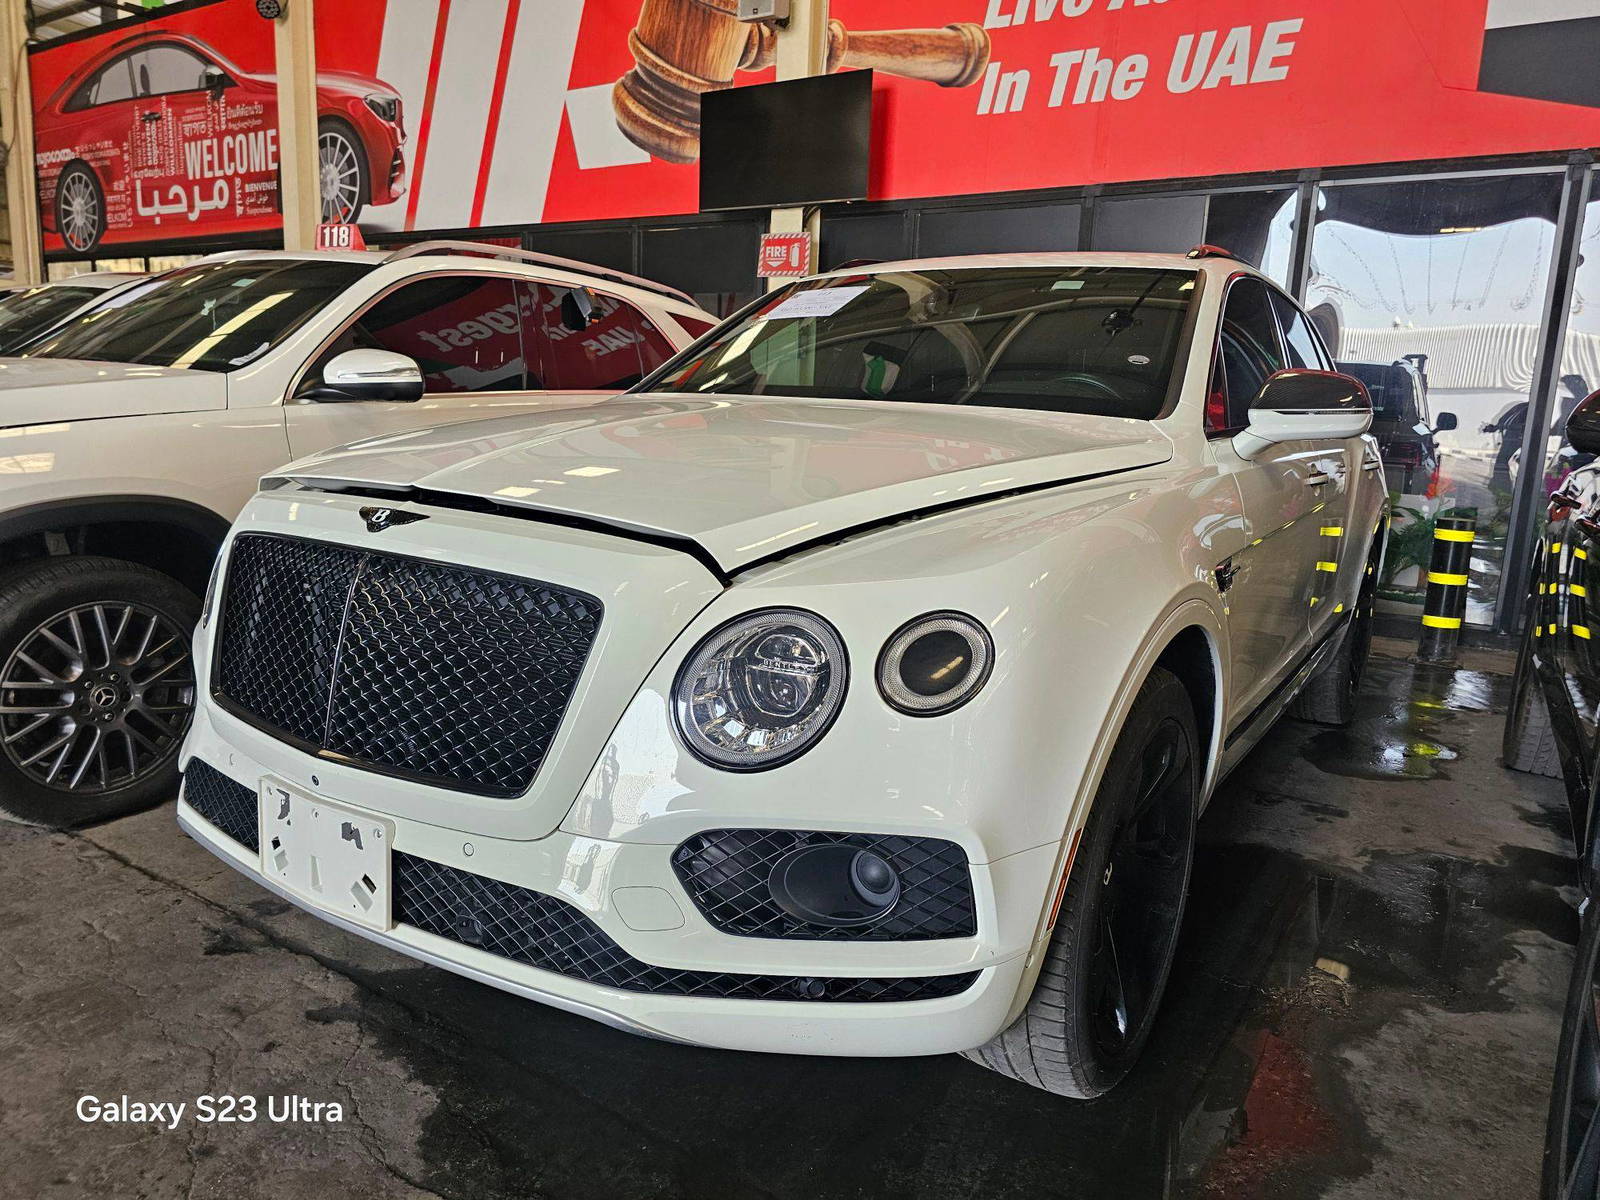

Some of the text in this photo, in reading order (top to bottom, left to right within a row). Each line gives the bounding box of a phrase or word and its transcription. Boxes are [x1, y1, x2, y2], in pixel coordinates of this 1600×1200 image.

[976, 18, 1304, 115] In The UAE
[184, 128, 278, 181] WELCOME
[135, 178, 230, 224] مرحبا
[245, 180, 277, 193] BIENVENUE
[323, 225, 350, 248] 118
[765, 245, 788, 258] FIRE
